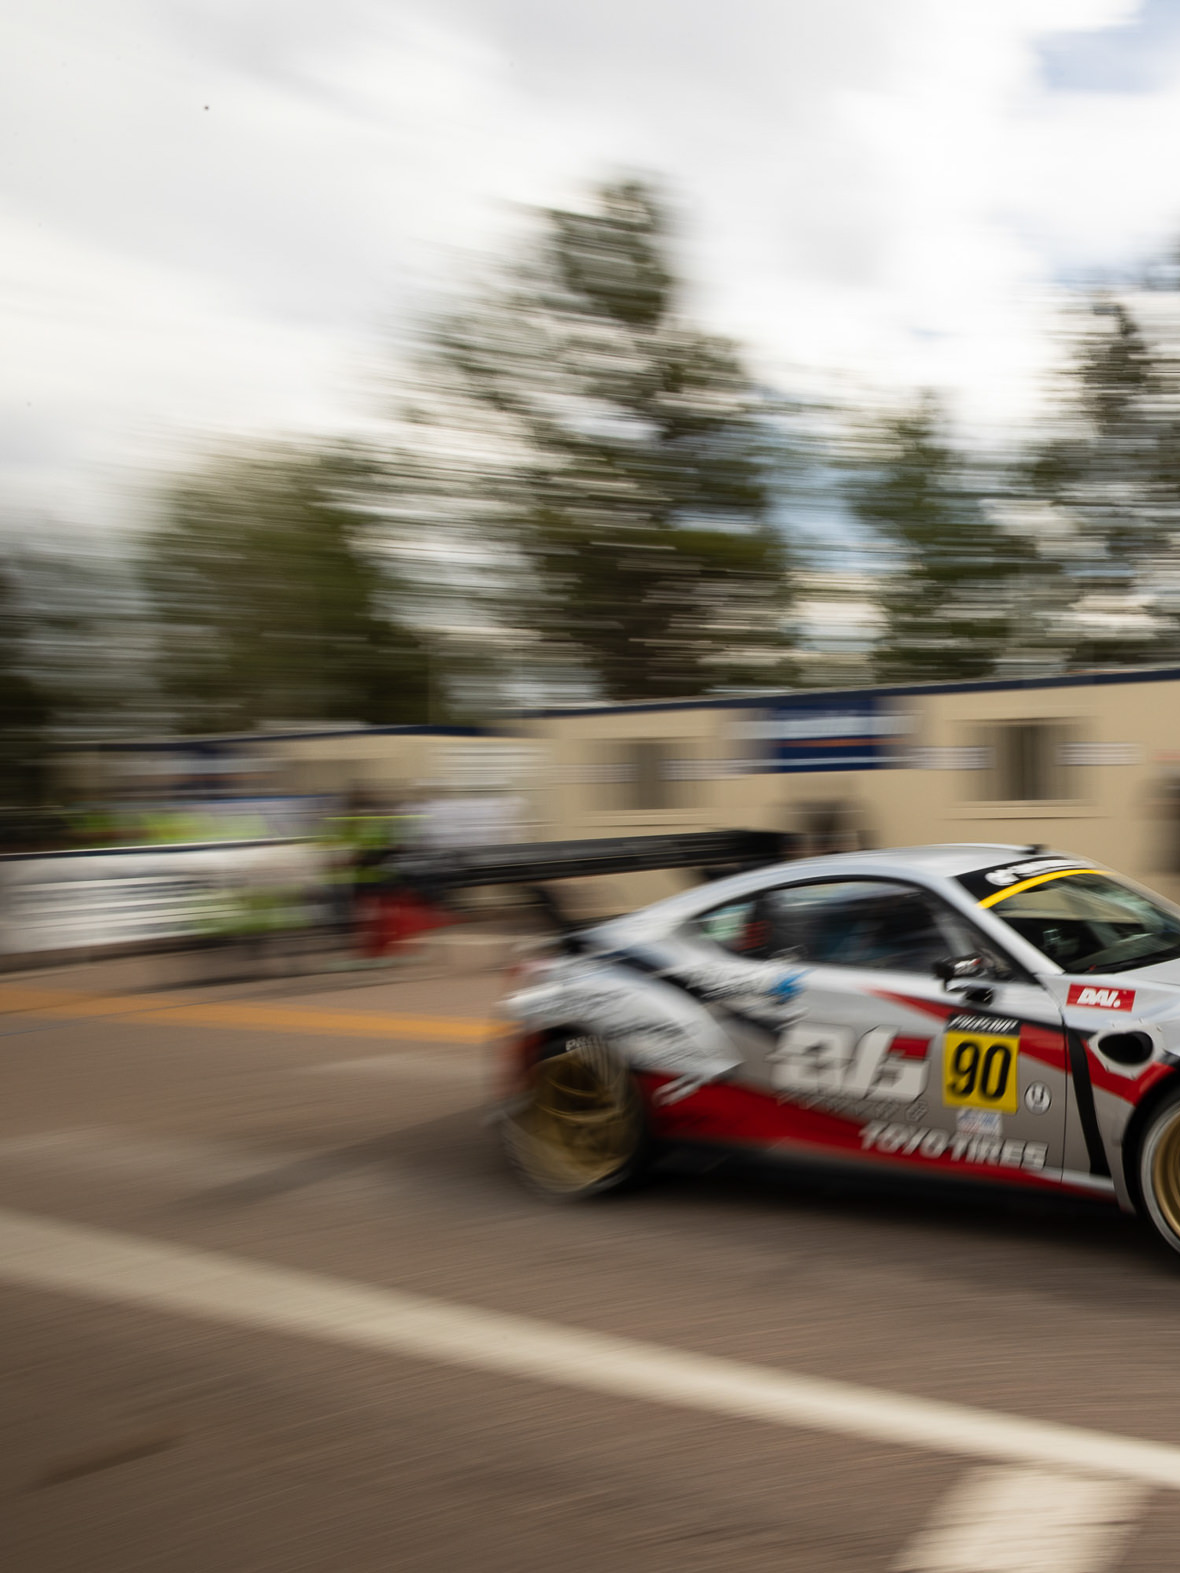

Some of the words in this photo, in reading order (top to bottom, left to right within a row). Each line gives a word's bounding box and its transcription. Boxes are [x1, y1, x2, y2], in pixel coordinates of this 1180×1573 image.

[947, 1040, 1012, 1100] 90
[859, 1119, 949, 1159] TOYO
[950, 1131, 1049, 1170] TIRES
